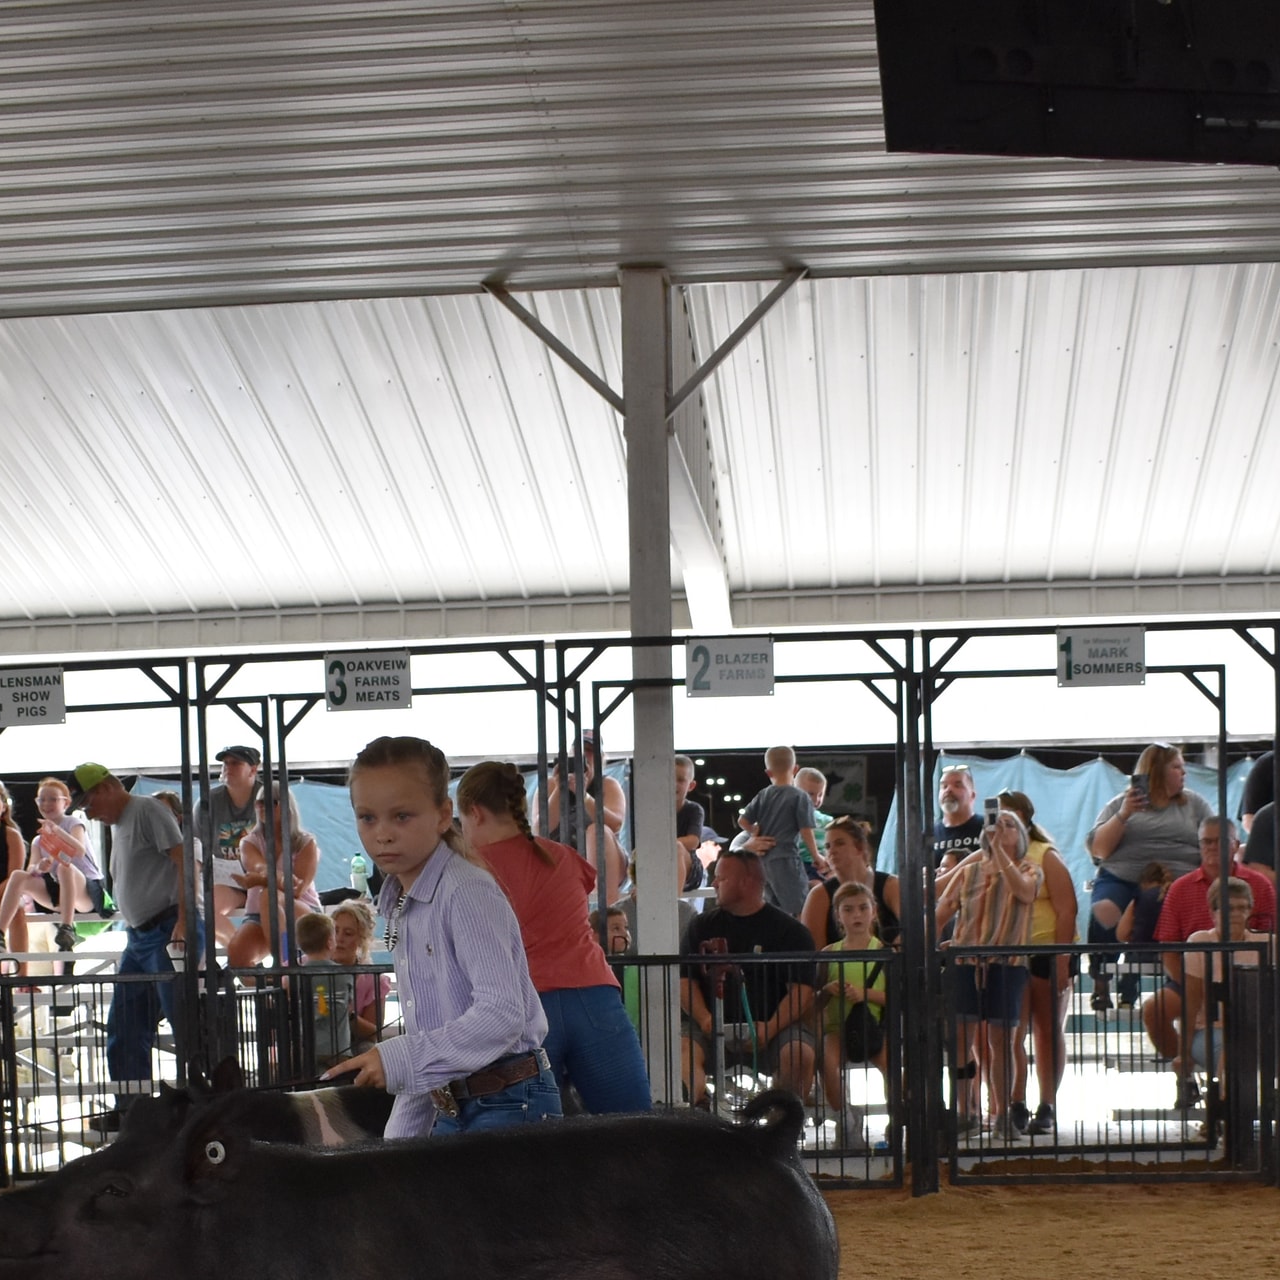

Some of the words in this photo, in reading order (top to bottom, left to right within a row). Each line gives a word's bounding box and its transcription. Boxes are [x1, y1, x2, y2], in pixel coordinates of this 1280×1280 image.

[715, 653, 768, 665] BLAZER
[1060, 636, 1072, 680] 1
[1088, 647, 1128, 659] MARK
[346, 659, 407, 672] OAKVEIW
[692, 645, 711, 690] 2
[1073, 662, 1143, 674] SOMMERS
[719, 668, 766, 680] FARMS
[0, 675, 61, 688] LENSMAN
[329, 660, 347, 706] 3
[355, 675, 400, 687] FARMS
[12, 691, 50, 703] SHOW
[356, 690, 400, 702] MEATS
[17, 706, 47, 718] PIGS
